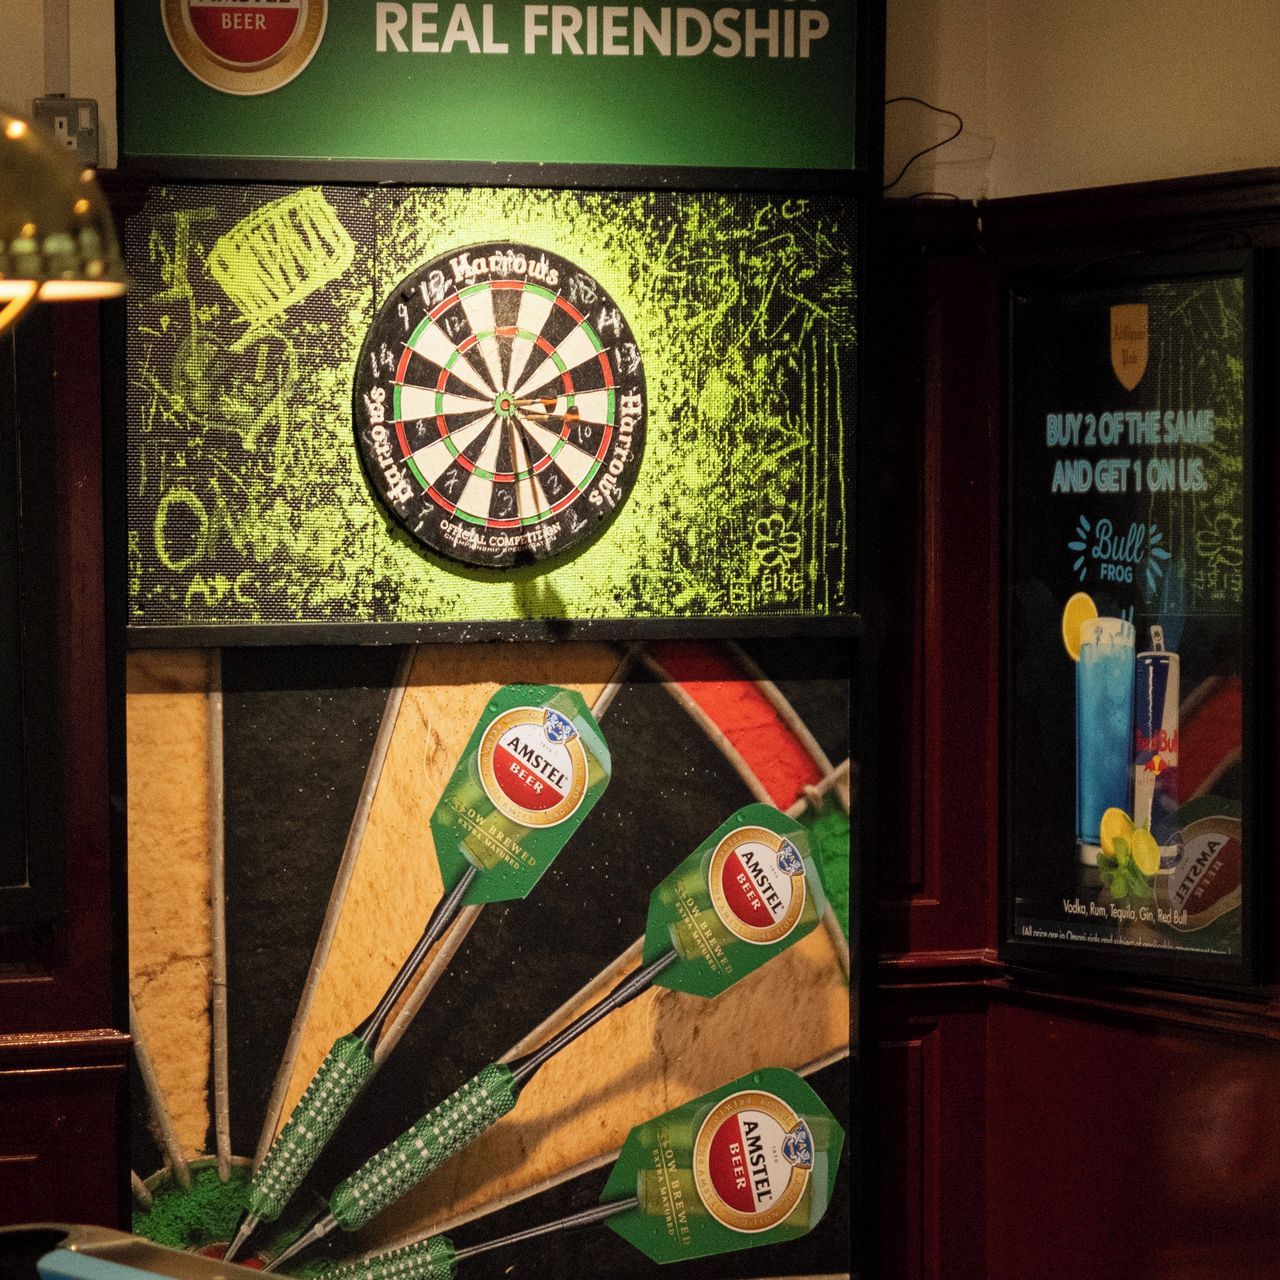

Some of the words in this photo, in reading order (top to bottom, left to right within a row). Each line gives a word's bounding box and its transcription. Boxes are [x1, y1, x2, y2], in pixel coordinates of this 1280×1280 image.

[221, 12, 267, 30] BEER
[375, 1, 509, 54] REAL
[524, 4, 830, 59] FRIENDSHIP
[449, 250, 560, 287] Harrows
[588, 394, 643, 507] Harrows
[1045, 413, 1083, 448] BUY
[1083, 413, 1098, 447] 2
[1098, 411, 1126, 447] OF
[1125, 410, 1162, 446] THE
[1163, 409, 1216, 446] SAME
[1051, 459, 1093, 493] AND
[1094, 458, 1132, 493] GET
[1132, 459, 1143, 493] 1
[1146, 458, 1177, 493] ON
[1177, 457, 1209, 493] US.
[440, 519, 487, 546] OFFICIAL
[489, 521, 562, 547] COMPETITION
[1091, 517, 1147, 566] Bull
[1099, 562, 1134, 584] FROG
[507, 736, 563, 789] AMSTEL
[509, 762, 544, 795] BEER
[457, 817, 481, 841] EXTRA
[484, 840, 520, 870] MATURED
[488, 825, 537, 867] BREWED
[736, 872, 761, 911] BEER
[741, 851, 783, 914] AMSTEL
[1063, 898, 1089, 917] Vodka,
[1089, 901, 1109, 919] Rum,
[1110, 904, 1138, 922] Tequila,
[1140, 906, 1156, 924] Gin,
[1158, 907, 1172, 923] Red
[1173, 907, 1188, 925] Bull
[675, 902, 693, 930] EXTRA
[692, 931, 718, 972] MATURED
[700, 921, 734, 974] BREWED
[729, 1142, 747, 1190] BEER
[743, 1121, 772, 1203] AMSTEL
[652, 1149, 665, 1183] EXTRA
[660, 1187, 676, 1236] MATURED
[671, 1180, 692, 1246] BREWED
